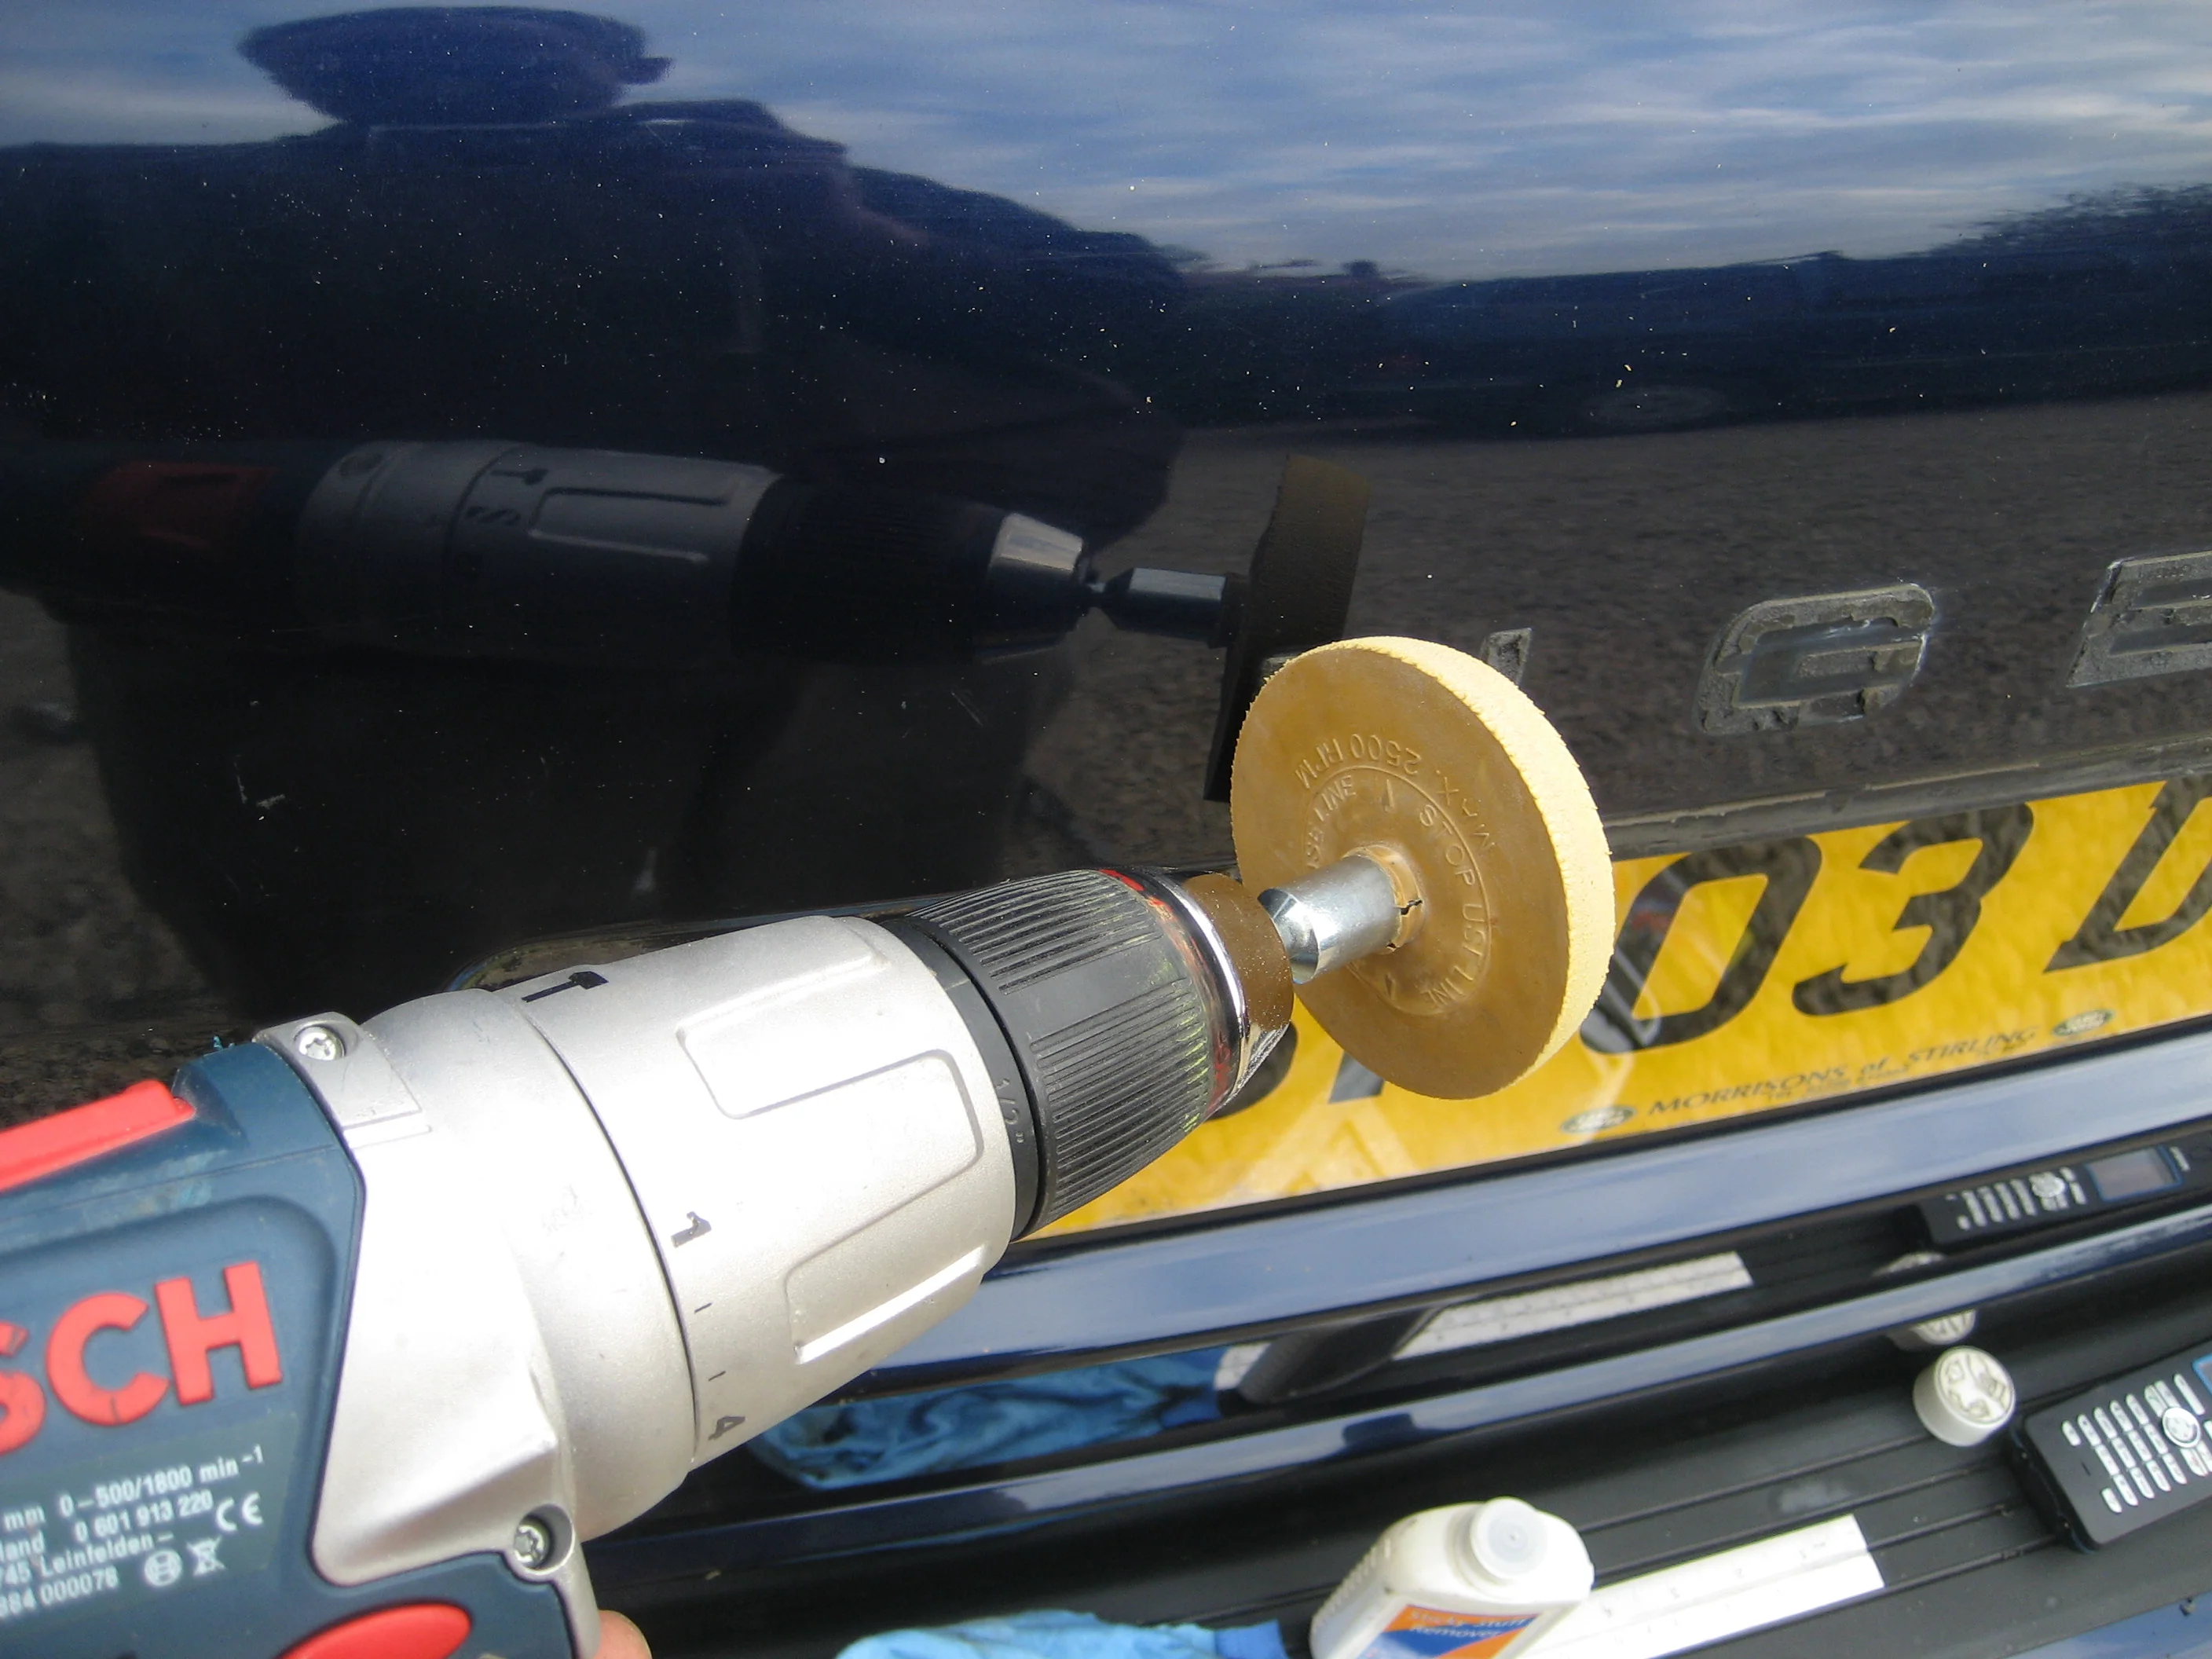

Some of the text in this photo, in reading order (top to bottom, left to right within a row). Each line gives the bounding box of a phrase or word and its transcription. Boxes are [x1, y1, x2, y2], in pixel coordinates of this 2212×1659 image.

[1295, 738, 1344, 789] RPM
[1350, 733, 1423, 776] 2500
[1419, 803, 1476, 887] STOP
[1647, 1062, 1851, 1116] MORRISONS
[1906, 1026, 2040, 1064] STIRLING
[74, 1520, 88, 1544] 0
[94, 1509, 130, 1538] 601
[136, 1499, 174, 1527] 913
[177, 1489, 214, 1518] 220
